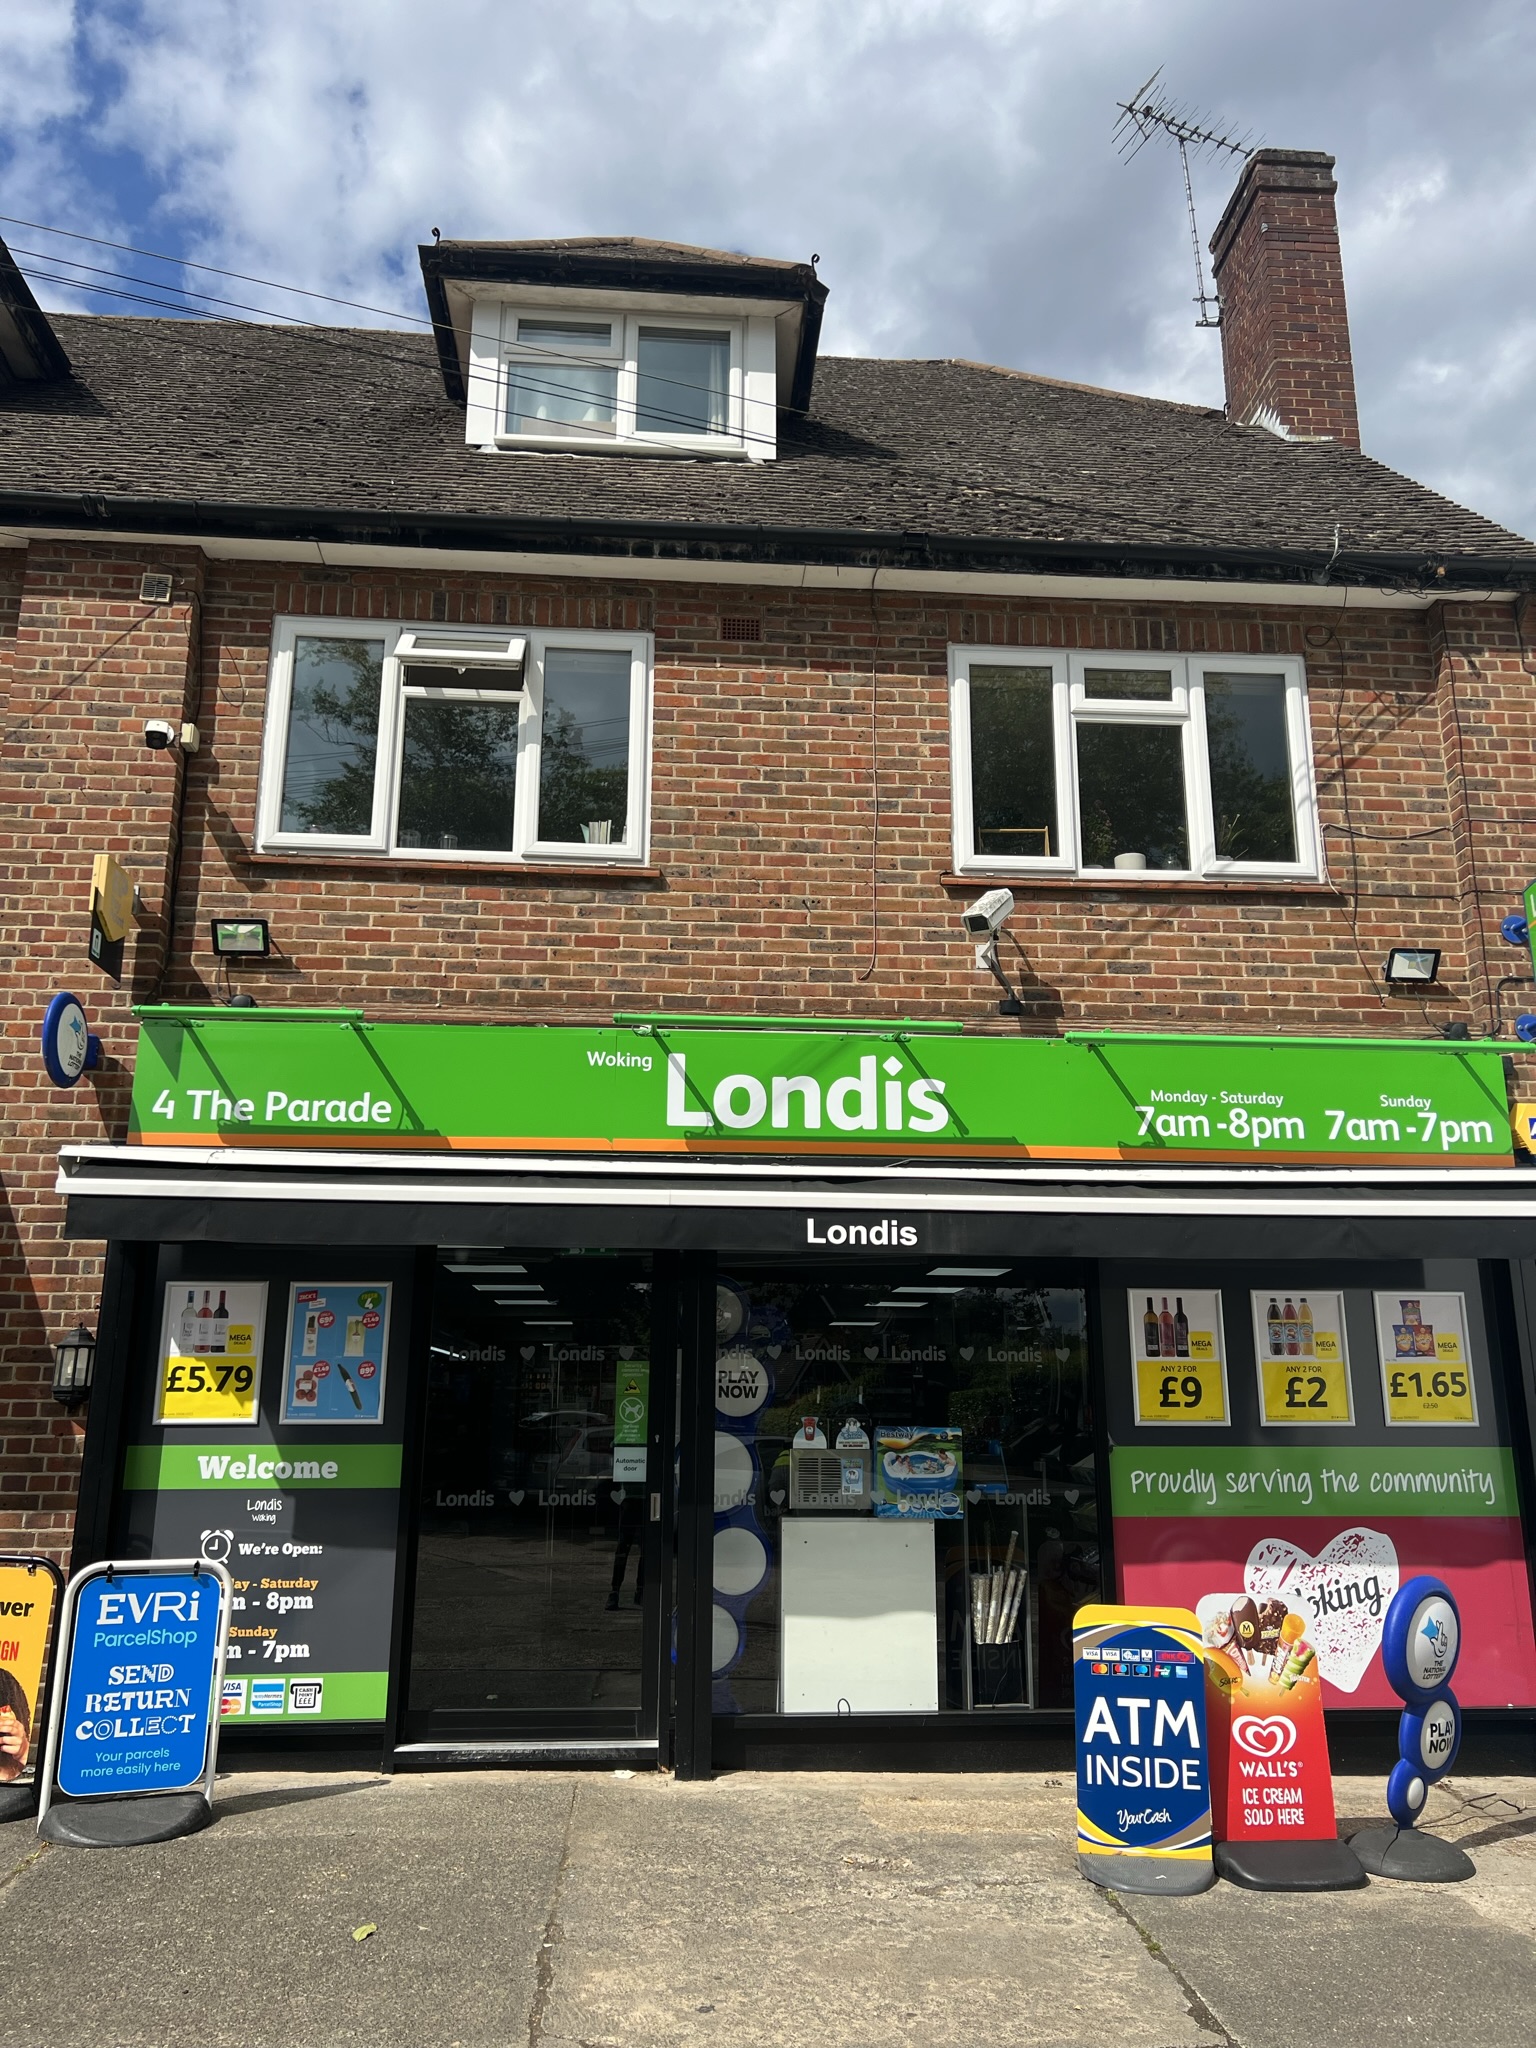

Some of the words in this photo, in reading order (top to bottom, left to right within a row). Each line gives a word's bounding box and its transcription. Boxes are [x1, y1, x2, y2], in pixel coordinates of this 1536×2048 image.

[586, 1050, 653, 1072] Woking
[666, 1053, 950, 1133] Londis
[1150, 1089, 1207, 1106] Monday
[1220, 1090, 1284, 1108] Saturday
[1379, 1094, 1432, 1111] Sunday
[151, 1089, 176, 1121] 4
[186, 1089, 255, 1122] The
[265, 1091, 392, 1124] Parade
[806, 1219, 918, 1247] Londis
[449, 1346, 506, 1362] Londis
[549, 1346, 606, 1362] Londis
[717, 1344, 753, 1360] ndis
[795, 1344, 851, 1362] Londis
[891, 1345, 946, 1362] Londis
[988, 1346, 1042, 1363] Londis
[165, 1365, 254, 1393] £5.79
[718, 1370, 759, 1384] PLAY
[1390, 1372, 1467, 1398] £1.65
[718, 1385, 759, 1399] NOW
[1159, 1376, 1203, 1408] £9
[1285, 1376, 1328, 1408] £2
[880, 1430, 915, 1440] Bestway
[198, 1454, 338, 1480] Welcome
[1130, 1468, 1217, 1505] Proudly
[1226, 1468, 1313, 1505] serving
[1320, 1468, 1360, 1494] the
[1370, 1468, 1496, 1505] community
[246, 1498, 282, 1512] Londis
[436, 1490, 494, 1506] Londis
[538, 1489, 596, 1506] Londis
[714, 1489, 756, 1506] ondis
[800, 1490, 856, 1506] Londis
[896, 1488, 952, 1506] Londis
[994, 1489, 1051, 1506] Londis
[282, 1542, 323, 1558] Open:
[260, 1576, 319, 1591] Saturday
[266, 1592, 314, 1614] 8pm
[1294, 1575, 1385, 1619] oking
[96, 1590, 201, 1625] EVRi
[94, 1628, 198, 1648] ParcelShop
[229, 1626, 278, 1640] Sunday
[262, 1640, 310, 1662] 7pm
[108, 1664, 174, 1686] SEND
[84, 1688, 192, 1714] RETURN
[75, 1714, 196, 1740] COLLECT
[1082, 1696, 1201, 1749] ATM
[1430, 1720, 1454, 1738] PLAY
[1428, 1736, 1454, 1754] NOW
[96, 1751, 123, 1763] Your
[125, 1748, 170, 1764] parcels
[80, 1766, 114, 1778] more
[116, 1762, 152, 1777] easily
[153, 1760, 181, 1772] here
[1086, 1754, 1202, 1791] INSIDE
[1242, 1788, 1260, 1805] ICE
[1263, 1786, 1303, 1804] CREAM
[1244, 1808, 1274, 1826] SOLD
[1277, 1808, 1305, 1825] HERE
